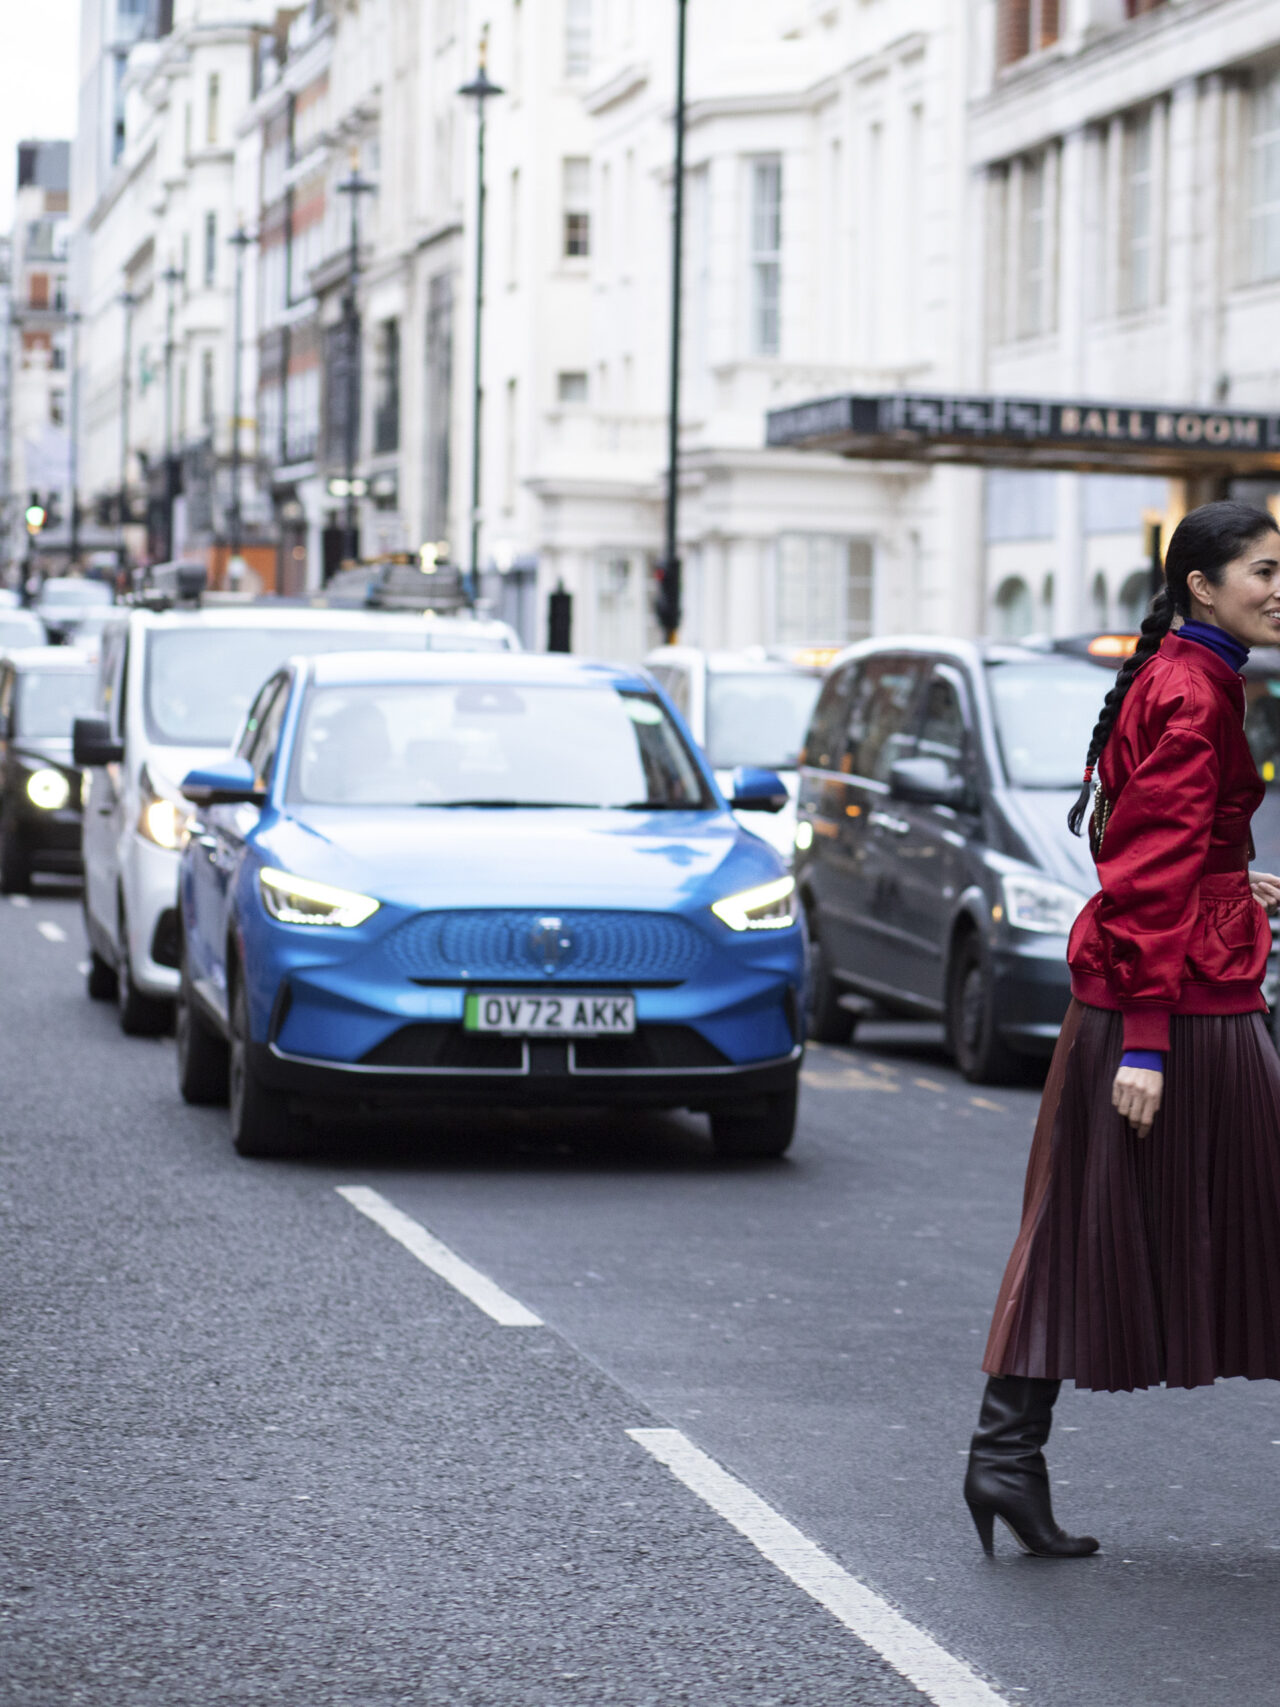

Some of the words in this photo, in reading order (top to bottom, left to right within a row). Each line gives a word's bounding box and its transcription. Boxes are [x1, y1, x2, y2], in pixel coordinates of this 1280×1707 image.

[1060, 408, 1143, 437] BALL
[1157, 412, 1259, 445] ROOM
[485, 999, 562, 1026] OV72
[573, 1001, 629, 1028] AKK
